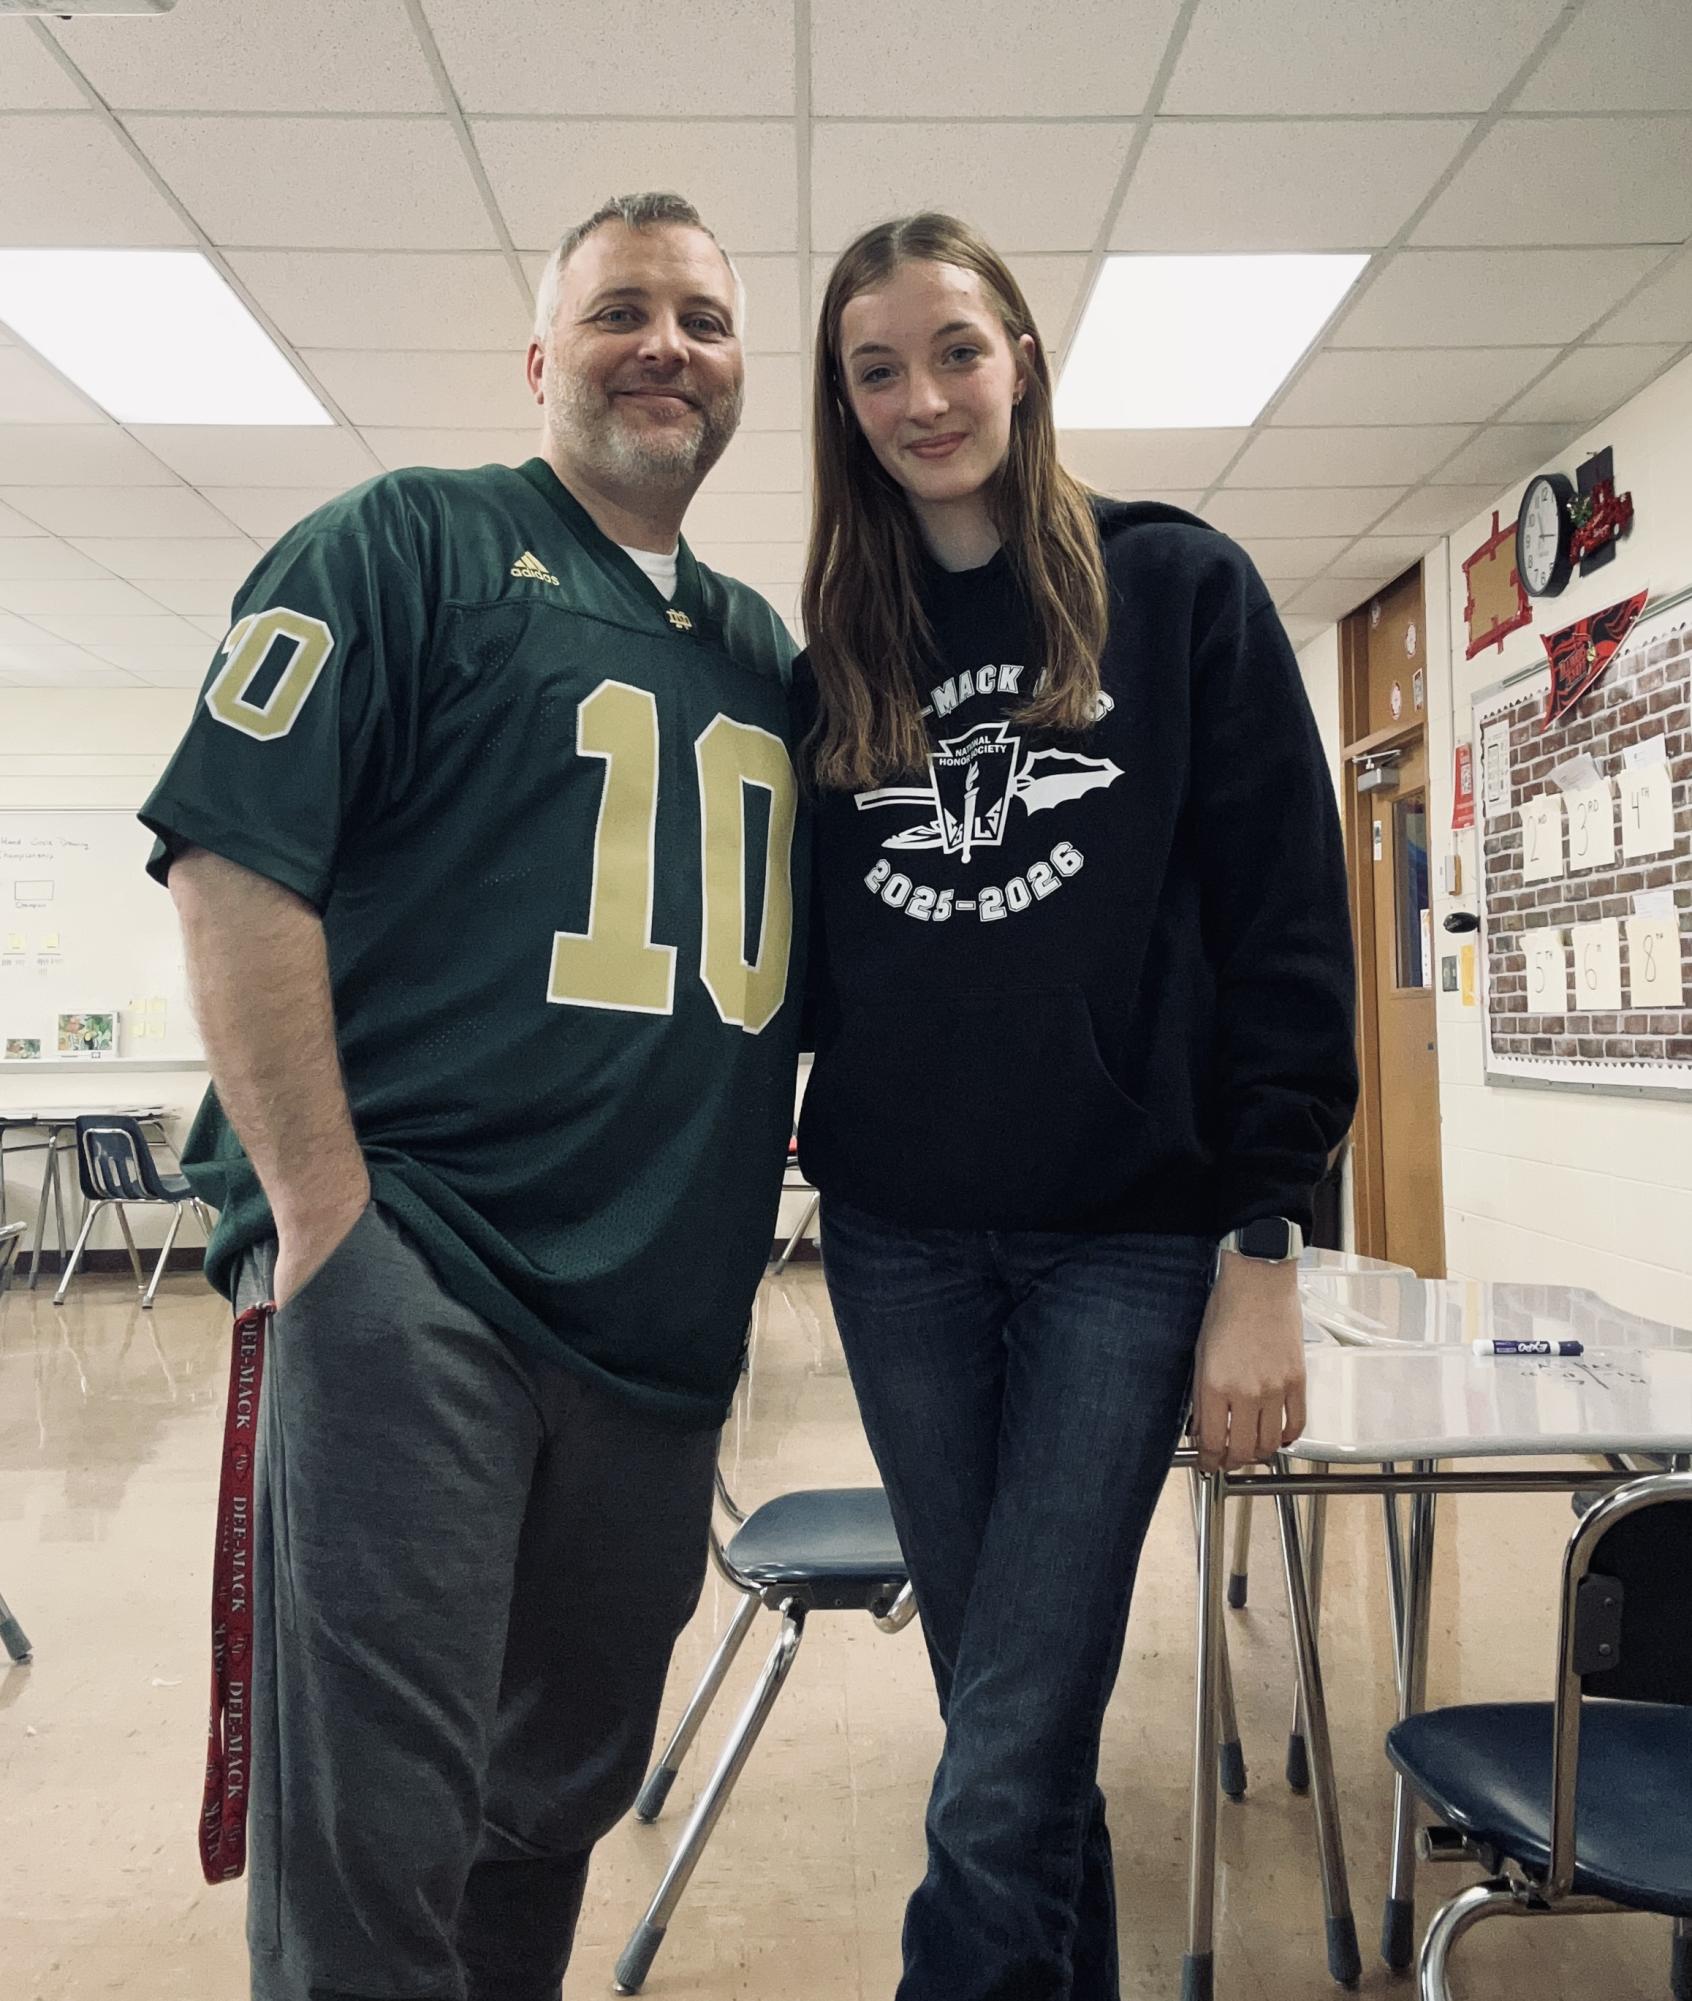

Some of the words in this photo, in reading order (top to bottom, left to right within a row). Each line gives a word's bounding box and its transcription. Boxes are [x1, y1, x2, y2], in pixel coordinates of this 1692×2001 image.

[510, 567, 560, 586] adidas
[917, 664, 1025, 720] -MACK
[547, 678, 798, 1035] 10
[864, 841, 1084, 922] 2025-2026
[235, 1315, 260, 1430] DEE-MACK
[231, 1496, 248, 1613] DEE-MACK
[227, 1680, 244, 1800] DEE-MACK
